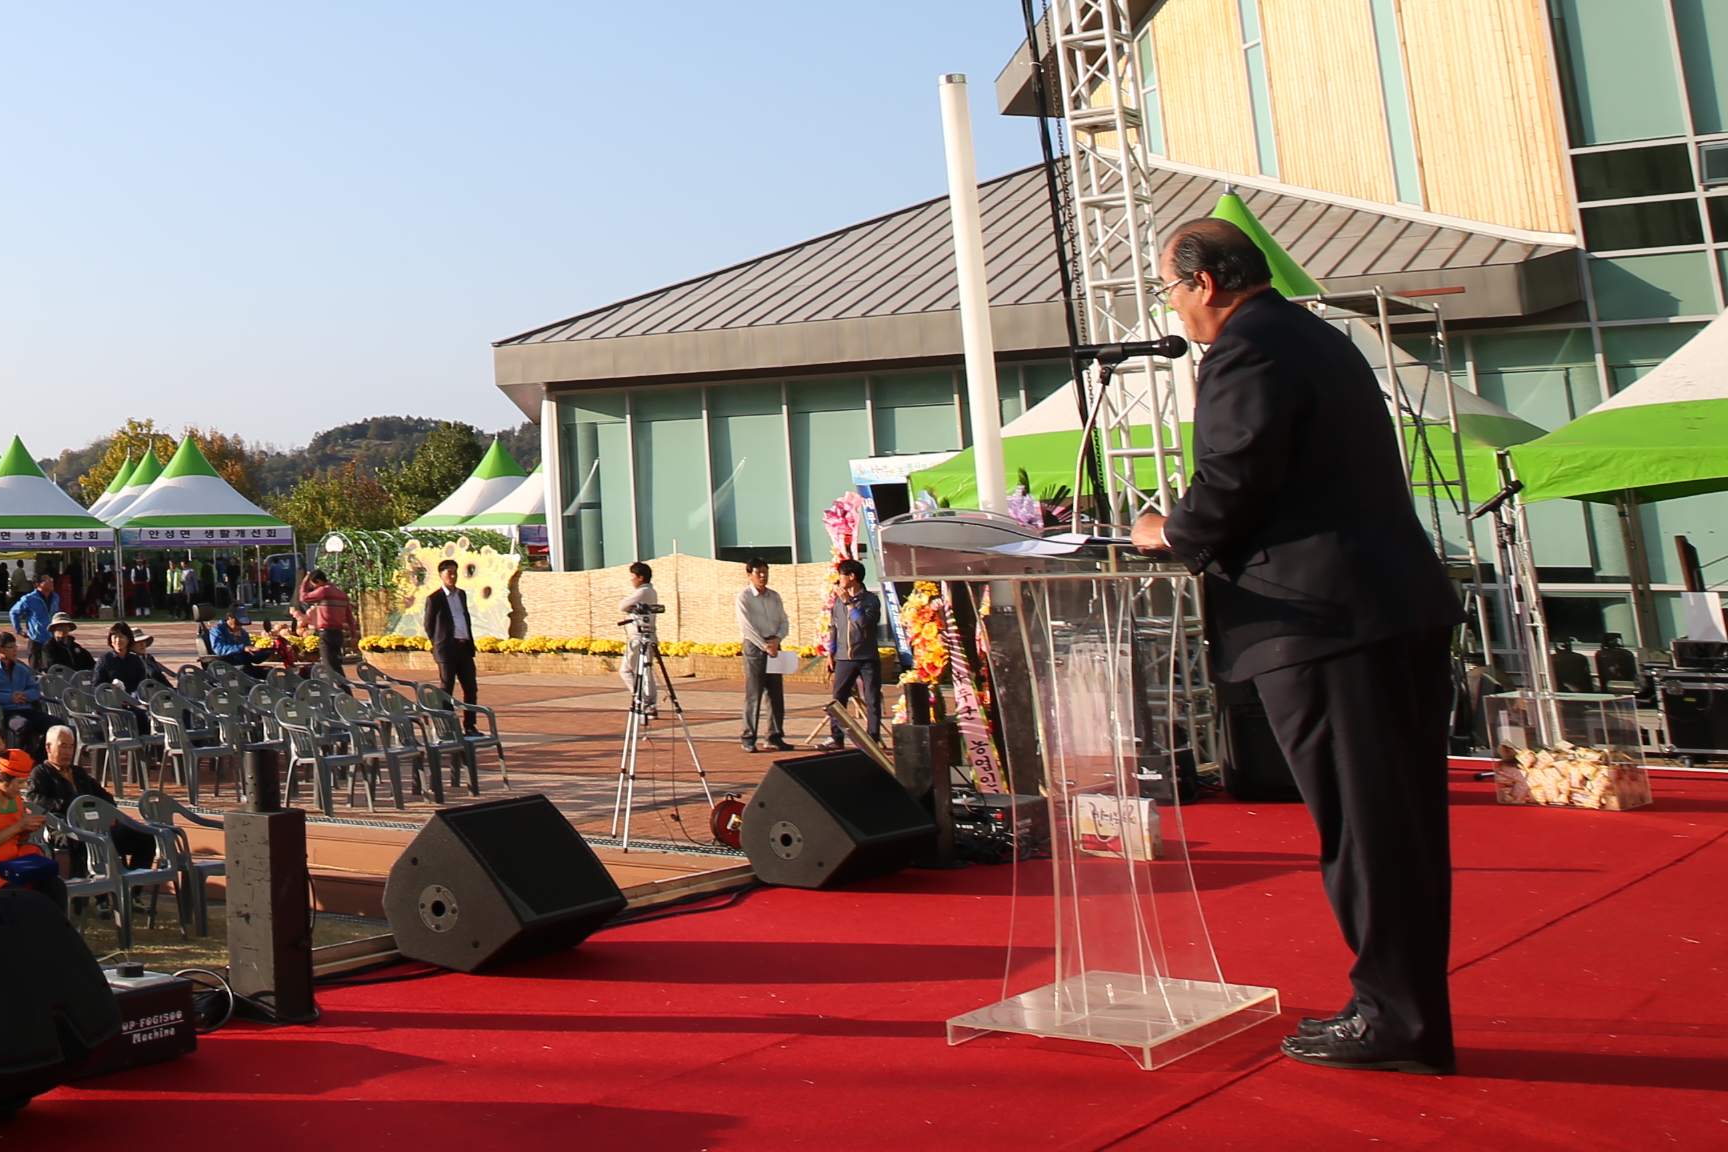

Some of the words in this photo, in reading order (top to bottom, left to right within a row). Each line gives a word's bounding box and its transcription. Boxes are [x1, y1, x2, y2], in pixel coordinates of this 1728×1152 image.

[24, 531, 99, 541] 생활개선회
[148, 529, 191, 540] 안성면
[203, 529, 277, 539] 생활개선회
[132, 1027, 176, 1044] Machine
